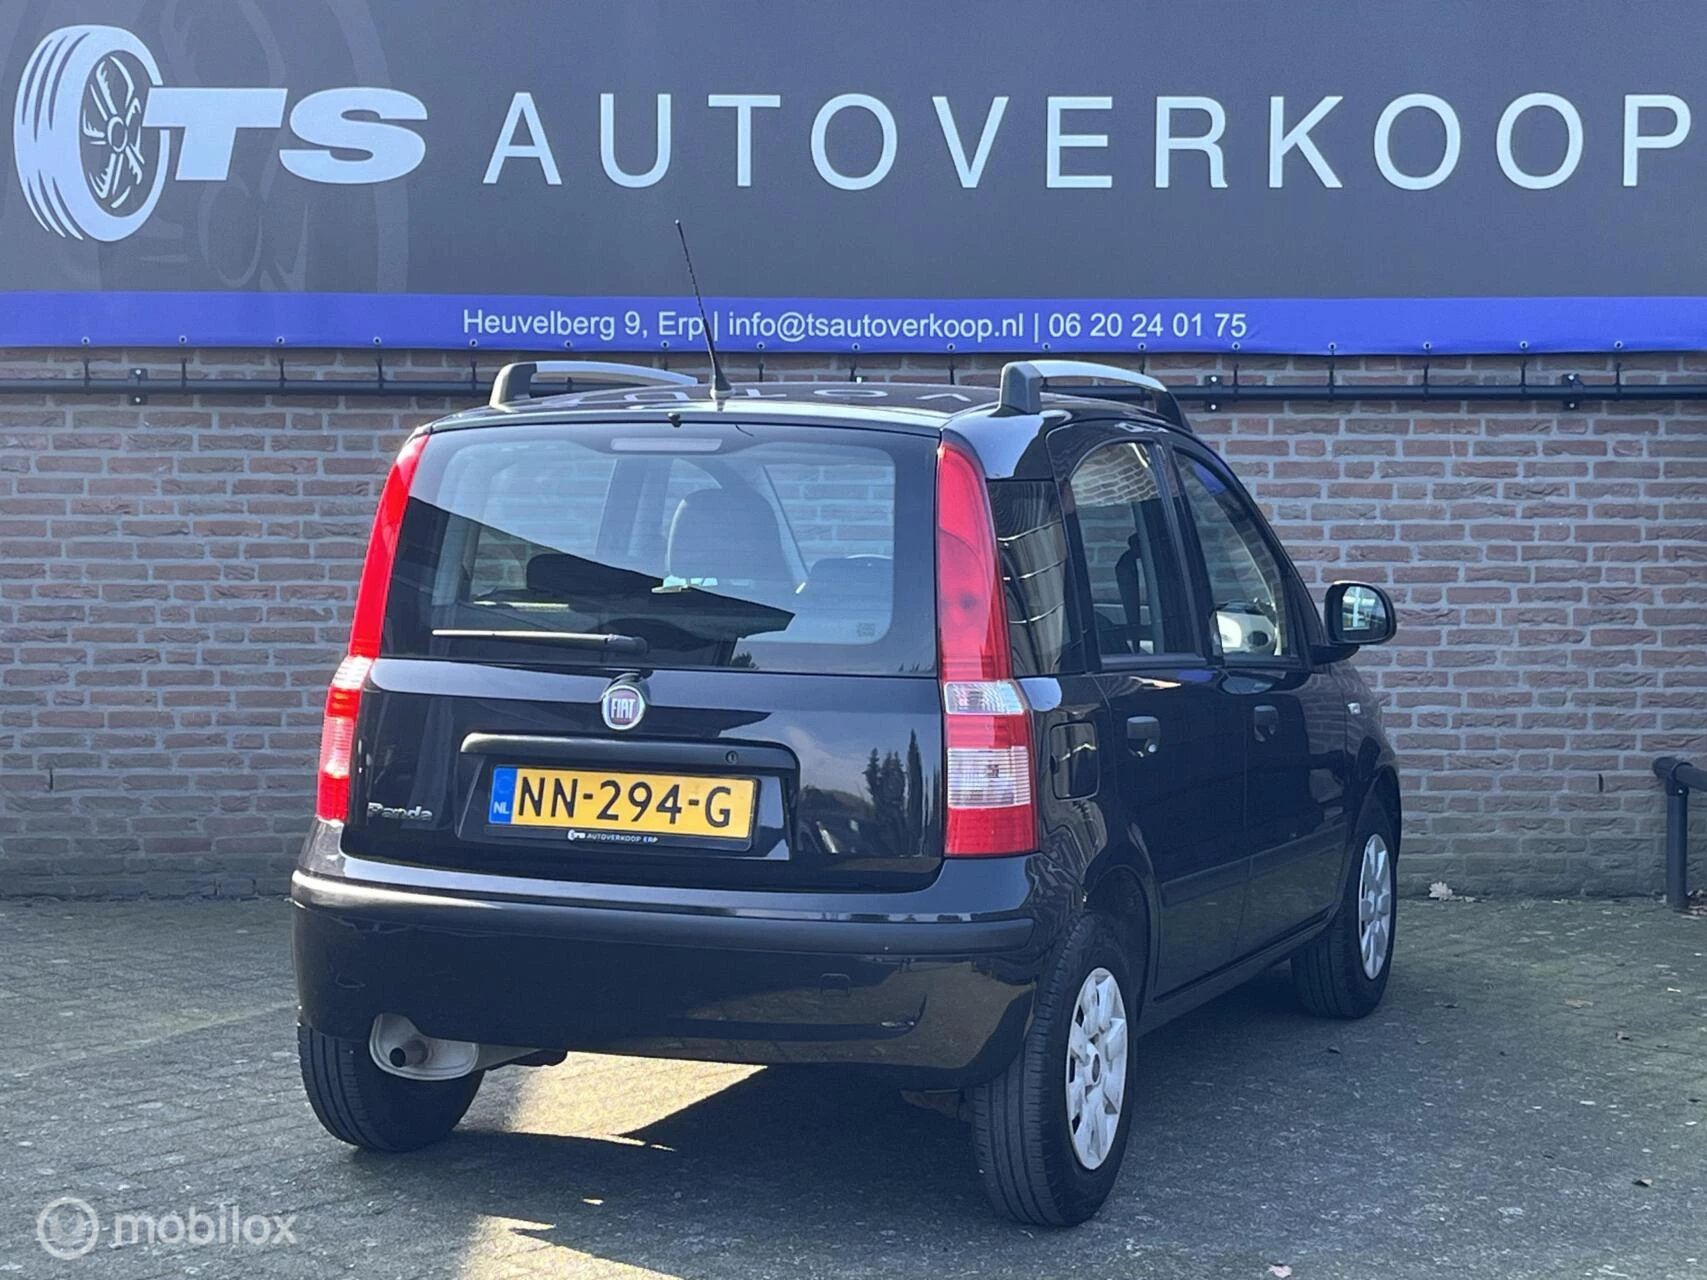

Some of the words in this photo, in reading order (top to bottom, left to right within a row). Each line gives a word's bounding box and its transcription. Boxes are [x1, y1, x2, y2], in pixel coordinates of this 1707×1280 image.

[141, 86, 428, 185] TS
[482, 92, 1693, 190] AUTOVERKOOP
[463, 308, 616, 341] Heuvelberg
[624, 310, 649, 339] 9,
[658, 311, 703, 341] Erp
[728, 311, 1024, 343] info@tsautoverkoop.nl
[1048, 313, 1081, 338] 06
[1089, 313, 1123, 338] 20
[1131, 313, 1164, 338] 24
[1172, 313, 1203, 338] 01
[1214, 313, 1248, 338] 75
[610, 697, 637, 719] FIAT
[367, 802, 433, 820] Panda
[493, 801, 510, 815] NL
[518, 776, 732, 828] NN-294-G
[587, 833, 642, 842] AUTOVERKOOP
